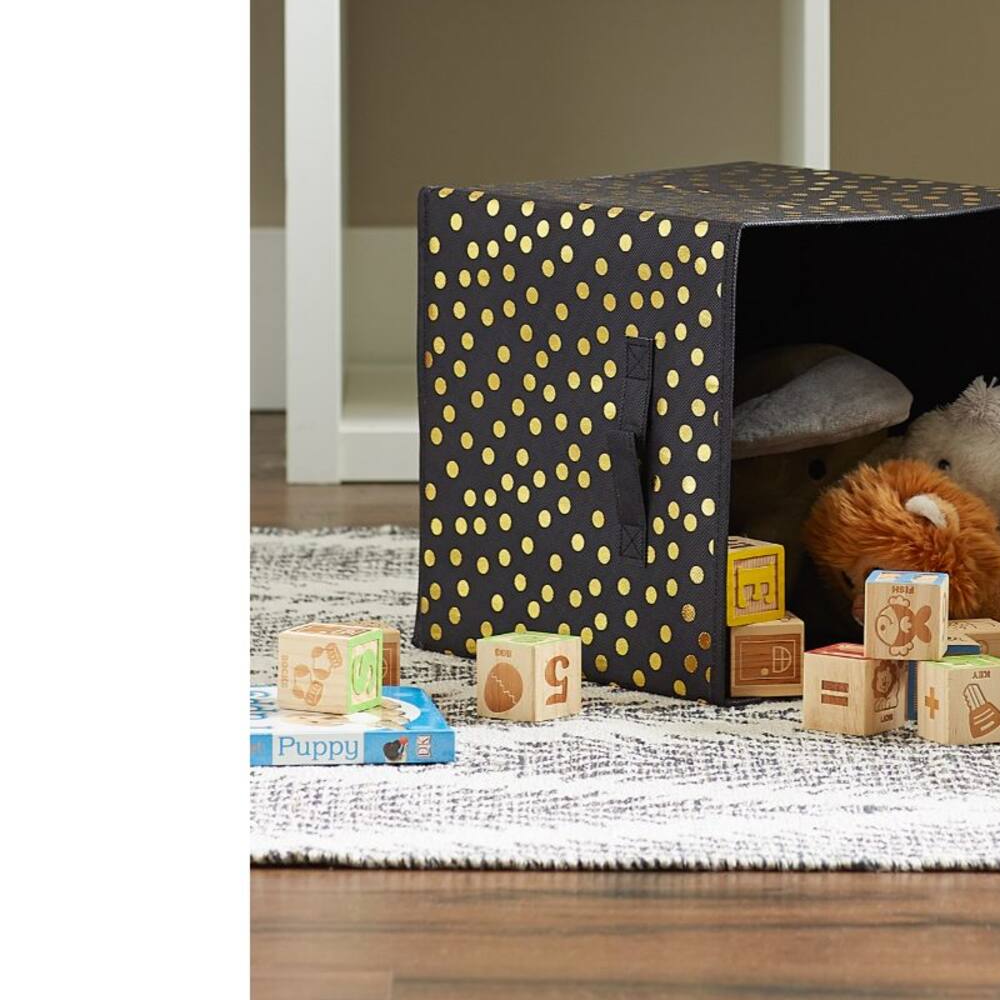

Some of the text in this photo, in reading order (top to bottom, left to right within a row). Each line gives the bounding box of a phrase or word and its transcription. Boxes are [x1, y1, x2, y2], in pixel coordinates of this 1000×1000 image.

[737, 564, 776, 609] E
[891, 585, 915, 594] FISH
[544, 655, 570, 706] 5
[972, 670, 991, 680] KEY
[278, 736, 358, 760] Puppy
[416, 736, 430, 758] DK
